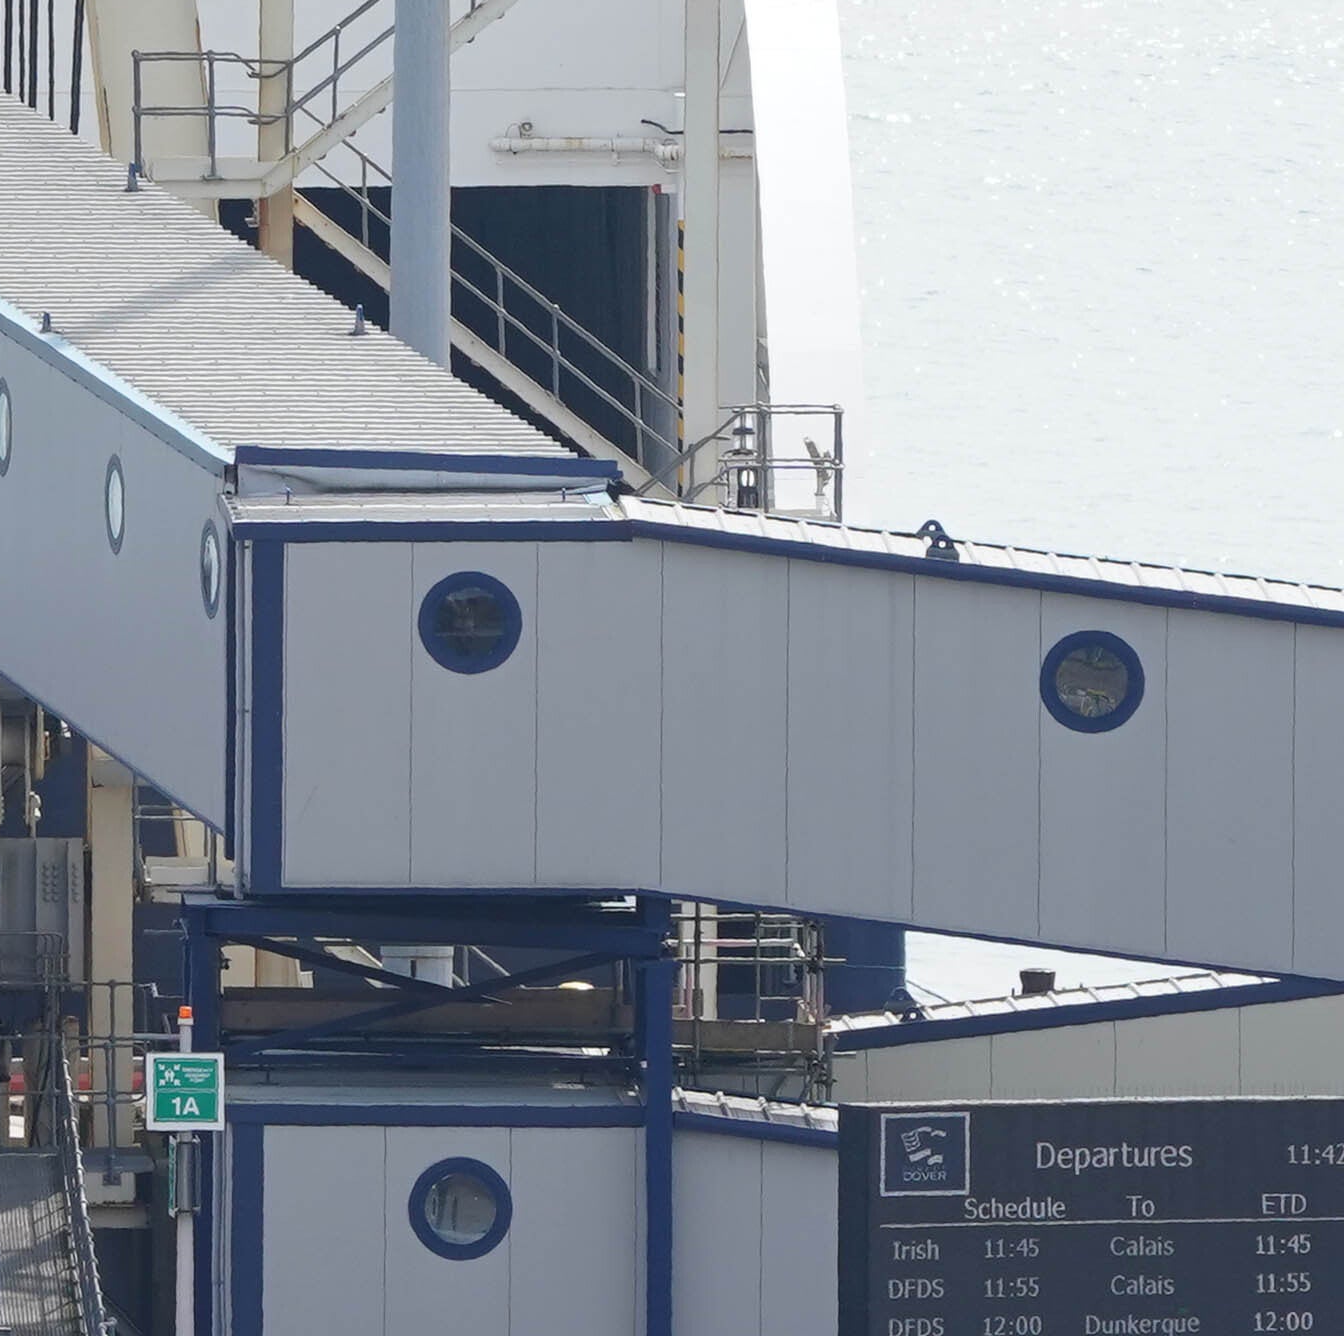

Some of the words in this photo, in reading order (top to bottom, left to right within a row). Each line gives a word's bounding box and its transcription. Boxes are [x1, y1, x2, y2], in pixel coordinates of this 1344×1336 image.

[171, 1096, 201, 1116] 1A
[1036, 1142, 1193, 1175] Departures
[1287, 1143, 1344, 1165] 11:42
[903, 1170, 947, 1181] DOVER
[964, 1196, 1067, 1220] Schedule
[1126, 1195, 1155, 1216] To
[1262, 1193, 1307, 1214] ETD
[892, 1239, 940, 1261] Irish
[984, 1238, 1040, 1259] 11:45
[1110, 1236, 1175, 1257] Calais
[1255, 1234, 1311, 1255] 11:45
[888, 1278, 945, 1299] DFDS
[983, 1276, 1040, 1298] 11:55
[1111, 1274, 1175, 1296] Calais
[1256, 1272, 1311, 1294] 11:55
[888, 1317, 945, 1336] DFDS
[983, 1315, 1042, 1336] 12:00
[1085, 1314, 1200, 1336] Dunkerque
[1254, 1311, 1313, 1332] 12:00
